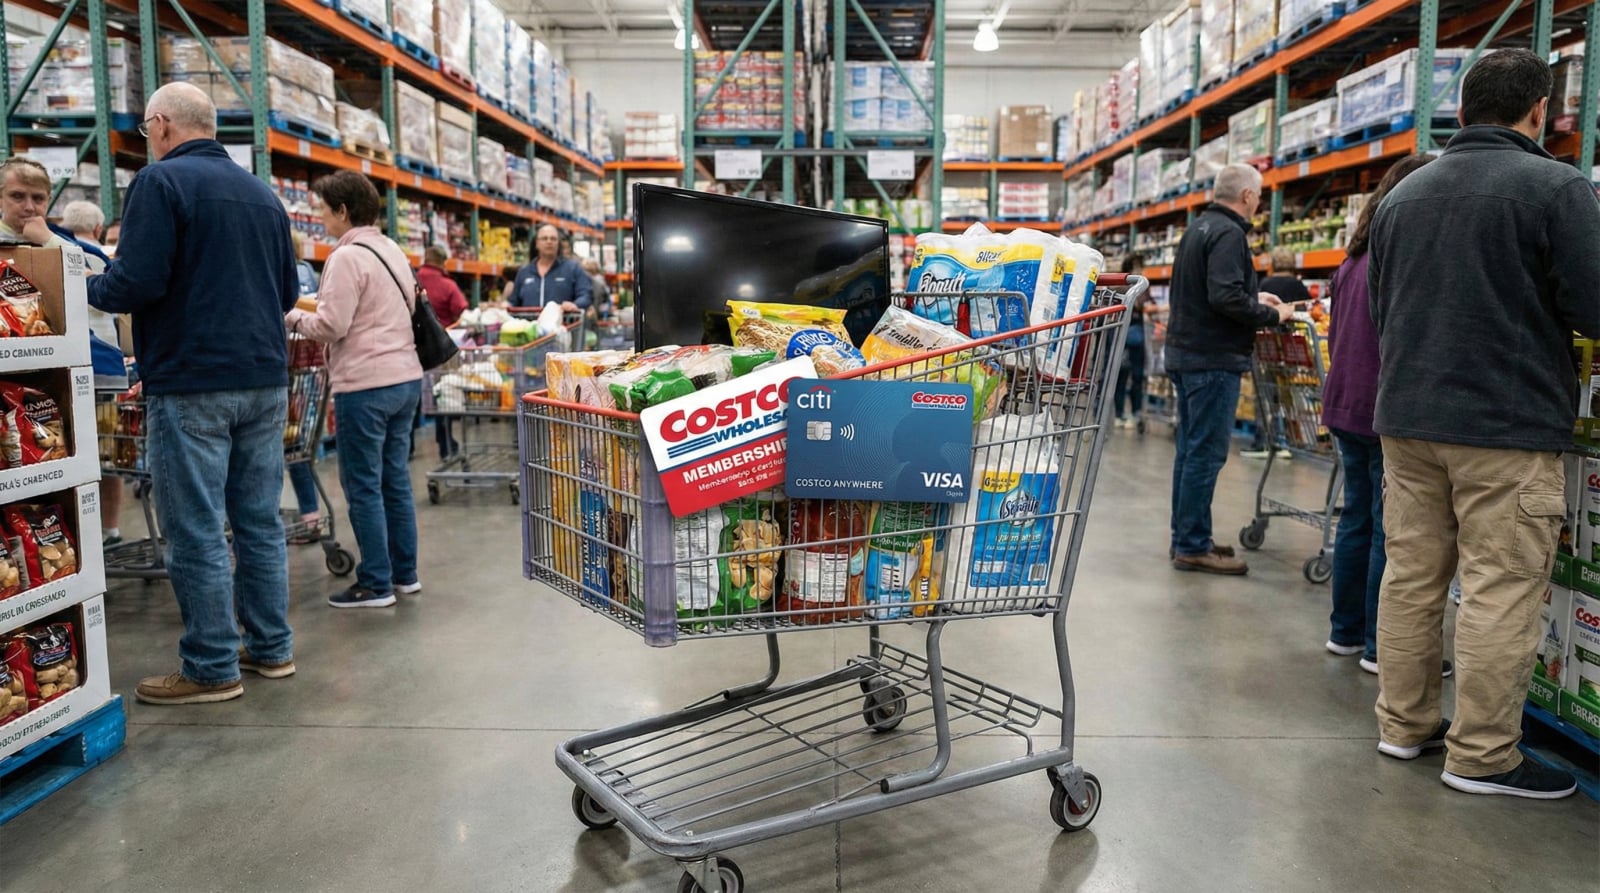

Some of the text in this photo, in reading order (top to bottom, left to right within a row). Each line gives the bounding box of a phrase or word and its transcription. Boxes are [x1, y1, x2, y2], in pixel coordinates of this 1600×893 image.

[912, 391, 967, 404] COSTCO
[796, 479, 884, 489] COSTCO ANYWHERE
[920, 471, 963, 488] VISA
[1575, 607, 1600, 628] COS
